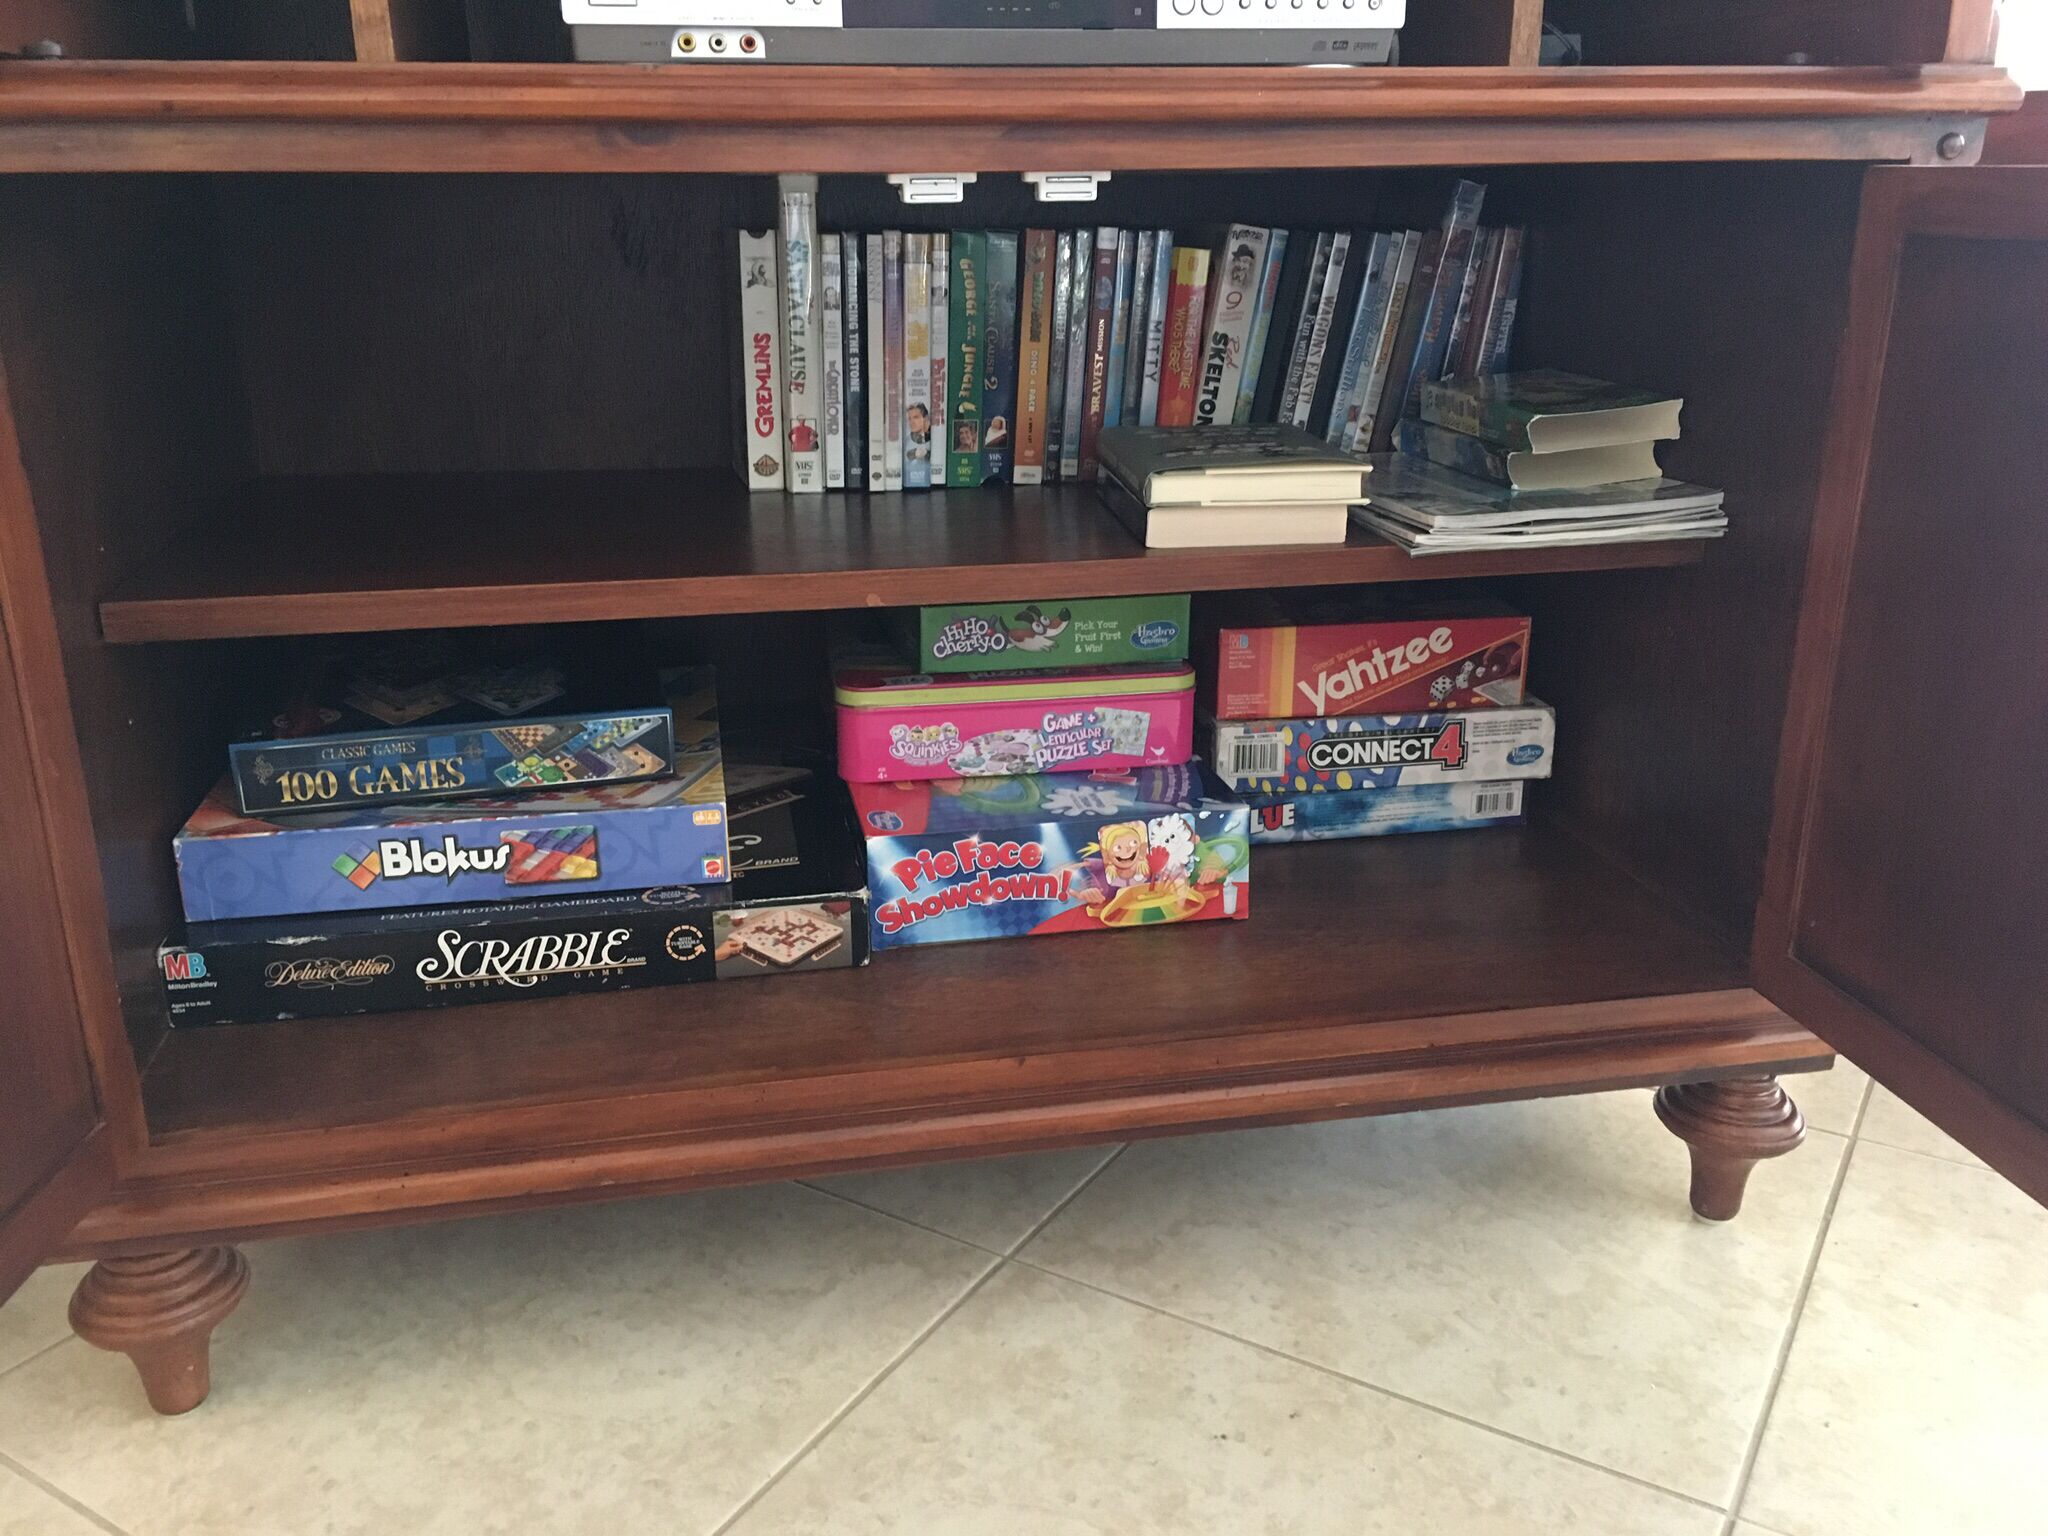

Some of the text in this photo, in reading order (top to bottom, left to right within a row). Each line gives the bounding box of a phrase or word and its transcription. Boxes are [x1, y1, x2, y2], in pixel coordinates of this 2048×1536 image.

[959, 258, 977, 318] GEORGE
[786, 240, 806, 395] SANTA CLAUSE
[987, 280, 999, 326] SANTA
[847, 260, 860, 393] ROMANCING THE STONE
[1302, 314, 1316, 336] Fun
[1309, 296, 1335, 357] WAGONS
[1029, 350, 1038, 375] DINO
[1145, 320, 1162, 382] MITTY
[1295, 339, 1309, 361] with
[958, 344, 977, 398] JUNGLE
[1089, 318, 1104, 415] BRAVEST MISSION
[1290, 365, 1302, 384] the
[754, 332, 772, 438] GREMLINS
[984, 376, 998, 391] 2
[1285, 387, 1299, 408] Fab
[1027, 389, 1036, 413] PACK
[1074, 620, 1118, 631] Pick Your
[1074, 630, 1122, 643] Fruit First
[1136, 624, 1176, 640] Hasbro
[1074, 643, 1104, 654] & Win!
[1297, 627, 1454, 716] Yahtzee
[1043, 713, 1083, 731] GAME
[321, 741, 416, 760] CLASSIC GAMES
[891, 737, 962, 760] SQUINKIES
[1035, 738, 1113, 767] PUZZLE SET
[1311, 737, 1434, 767] CONNECT
[1431, 724, 1463, 765] 4
[275, 756, 467, 804] 100 GAMES
[1250, 803, 1295, 833] LUE
[380, 837, 512, 885] Blokus
[755, 856, 800, 867] BRAND
[889, 838, 1043, 893] Pie Face
[381, 896, 637, 920] FEATURES ROTATING GAMEBOARD
[873, 870, 1074, 935] Showdown!
[163, 952, 207, 981] MB
[265, 956, 393, 988] Deluxe Edition
[415, 928, 630, 988] SCRABBLE
[573, 966, 625, 979] GAME
